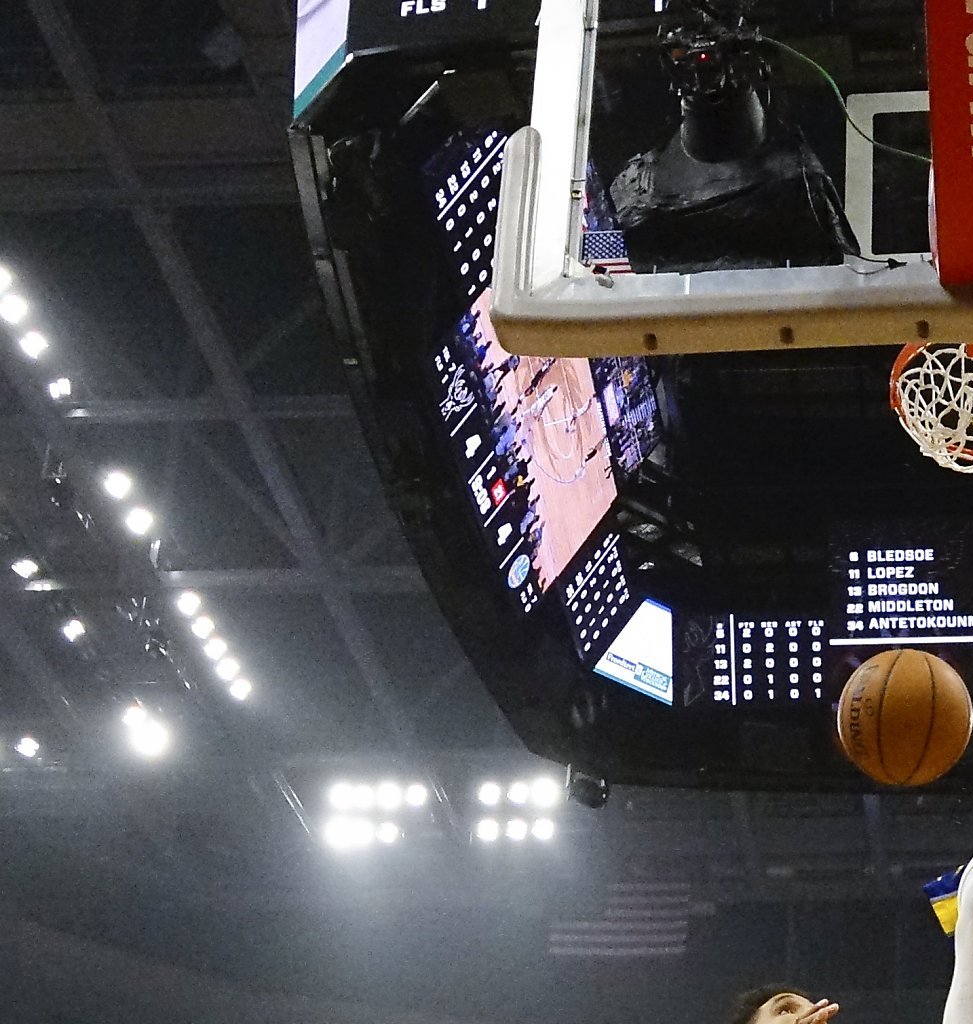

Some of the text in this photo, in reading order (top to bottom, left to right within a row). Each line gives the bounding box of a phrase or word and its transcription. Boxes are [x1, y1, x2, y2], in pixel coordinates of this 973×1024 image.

[401, 0, 446, 17] FLS
[866, 549, 934, 562] BLEDSOE
[867, 566, 915, 579] LOPEZ
[867, 582, 939, 596] BROGDON
[868, 599, 954, 613] MIDDLETON
[714, 641, 822, 655] 11 0 2 0 0
[743, 658, 752, 669] 2
[765, 657, 775, 669] 0
[789, 657, 799, 668] 0
[812, 656, 822, 667] 0
[743, 674, 753, 685] 0
[767, 673, 774, 684] 1
[789, 673, 799, 684] 0
[812, 672, 822, 683] 0
[743, 689, 753, 700] 0
[767, 689, 774, 700] 1
[789, 688, 800, 699] 0
[814, 688, 821, 699] 1
